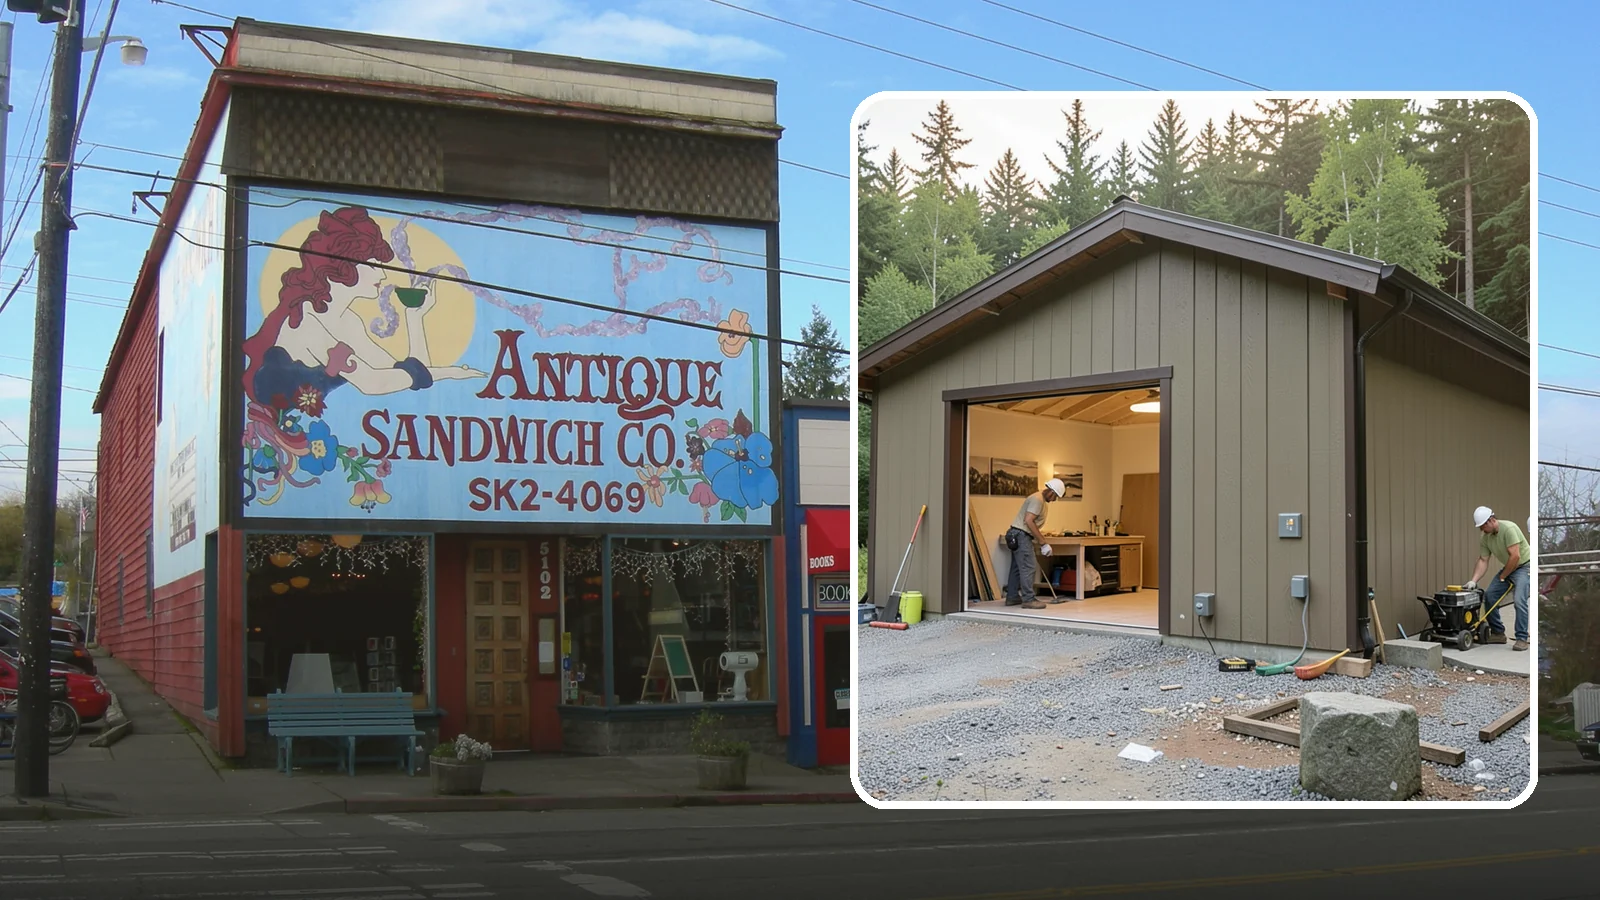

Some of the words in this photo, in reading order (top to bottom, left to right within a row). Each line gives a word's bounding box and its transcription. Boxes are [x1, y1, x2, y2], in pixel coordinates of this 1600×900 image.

[476, 329, 723, 420] ANTIQUE
[361, 408, 604, 466] SANDWICH
[617, 423, 684, 468] CO.
[468, 477, 646, 513] SK2-4069
[540, 542, 551, 599] 5102
[809, 555, 835, 568] BOOKS
